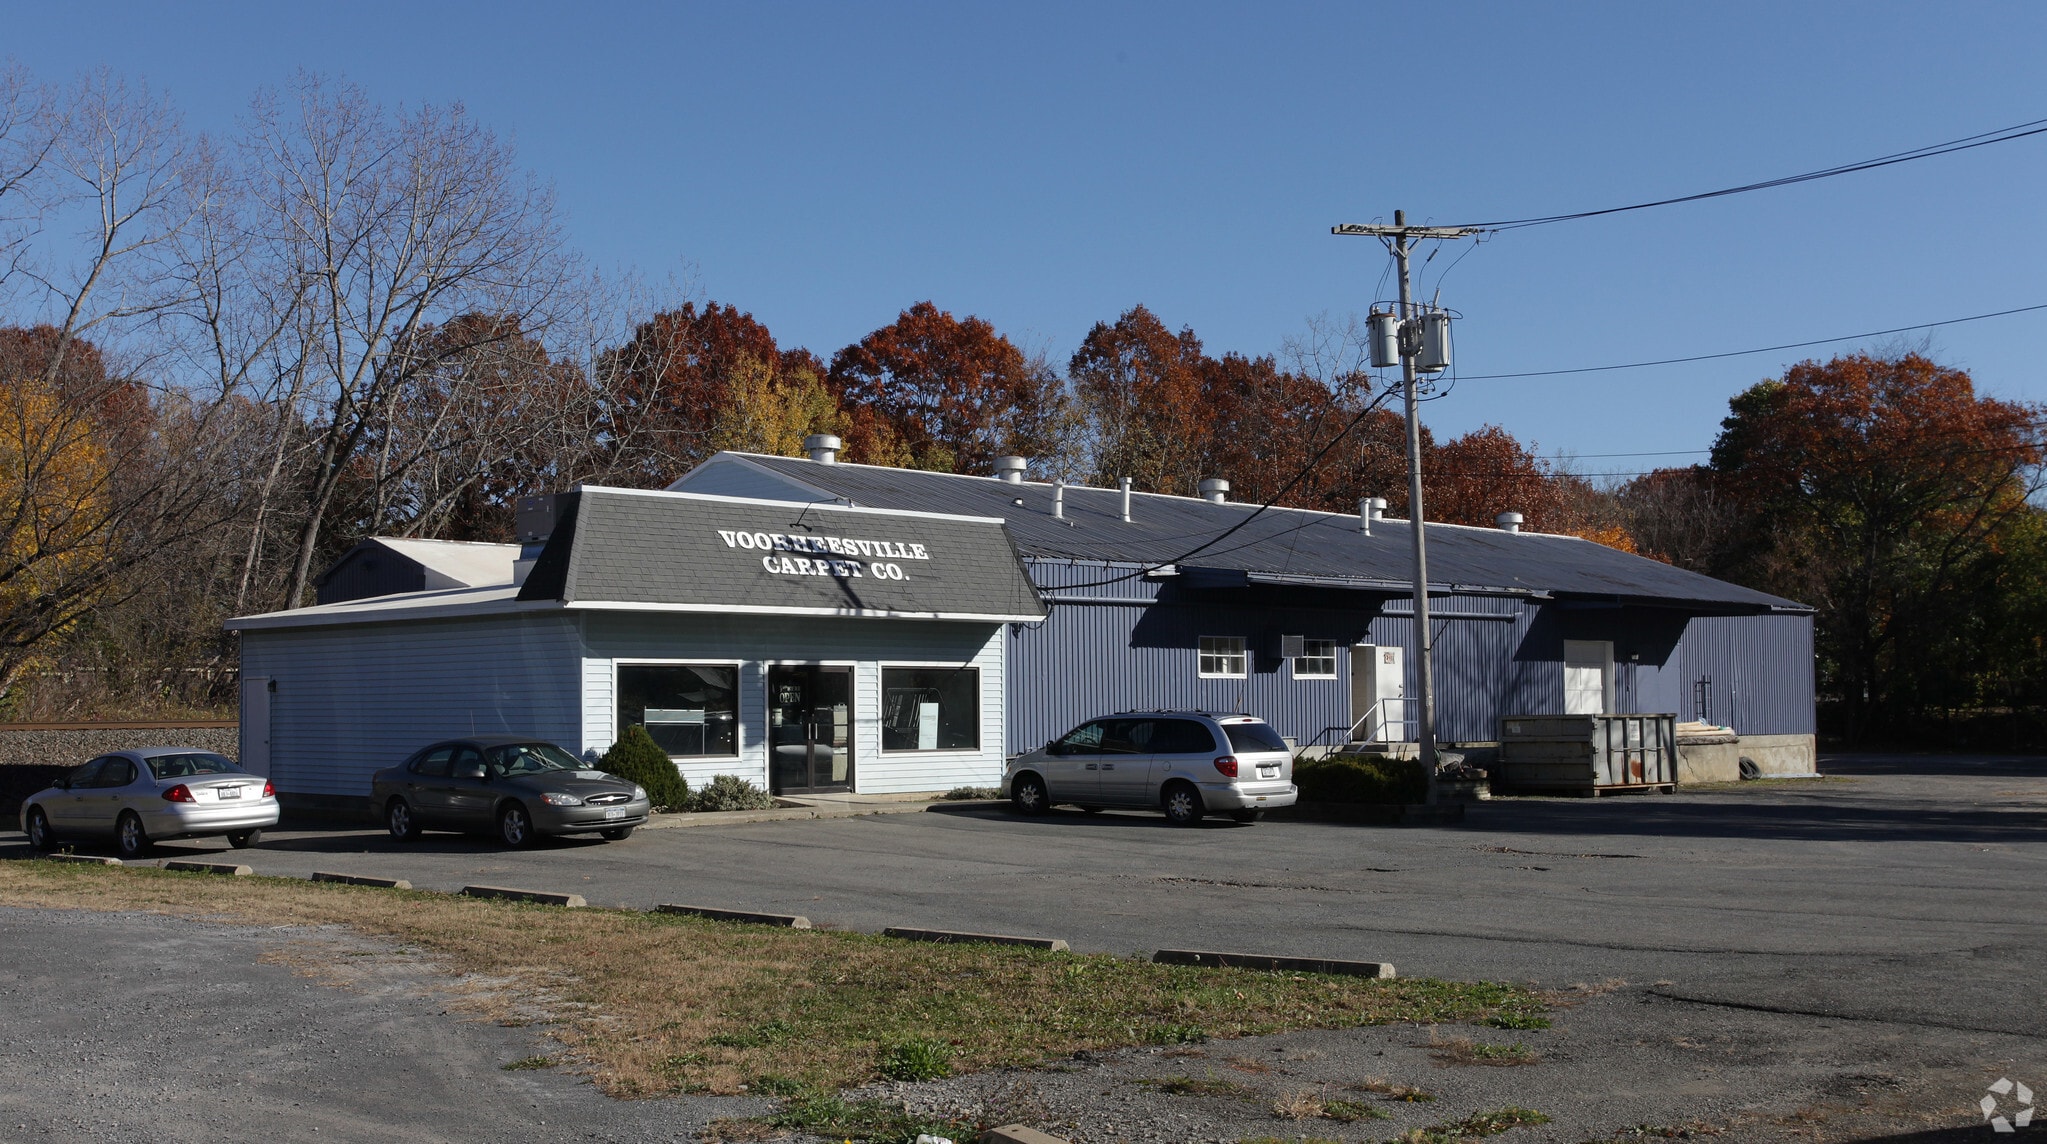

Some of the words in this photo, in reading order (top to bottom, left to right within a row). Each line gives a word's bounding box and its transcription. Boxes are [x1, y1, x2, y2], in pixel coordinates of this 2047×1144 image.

[717, 530, 930, 560] VOORHEESVILLE
[762, 556, 861, 578] CARPET
[870, 562, 911, 581] CO.
[779, 692, 801, 703] OPEN
